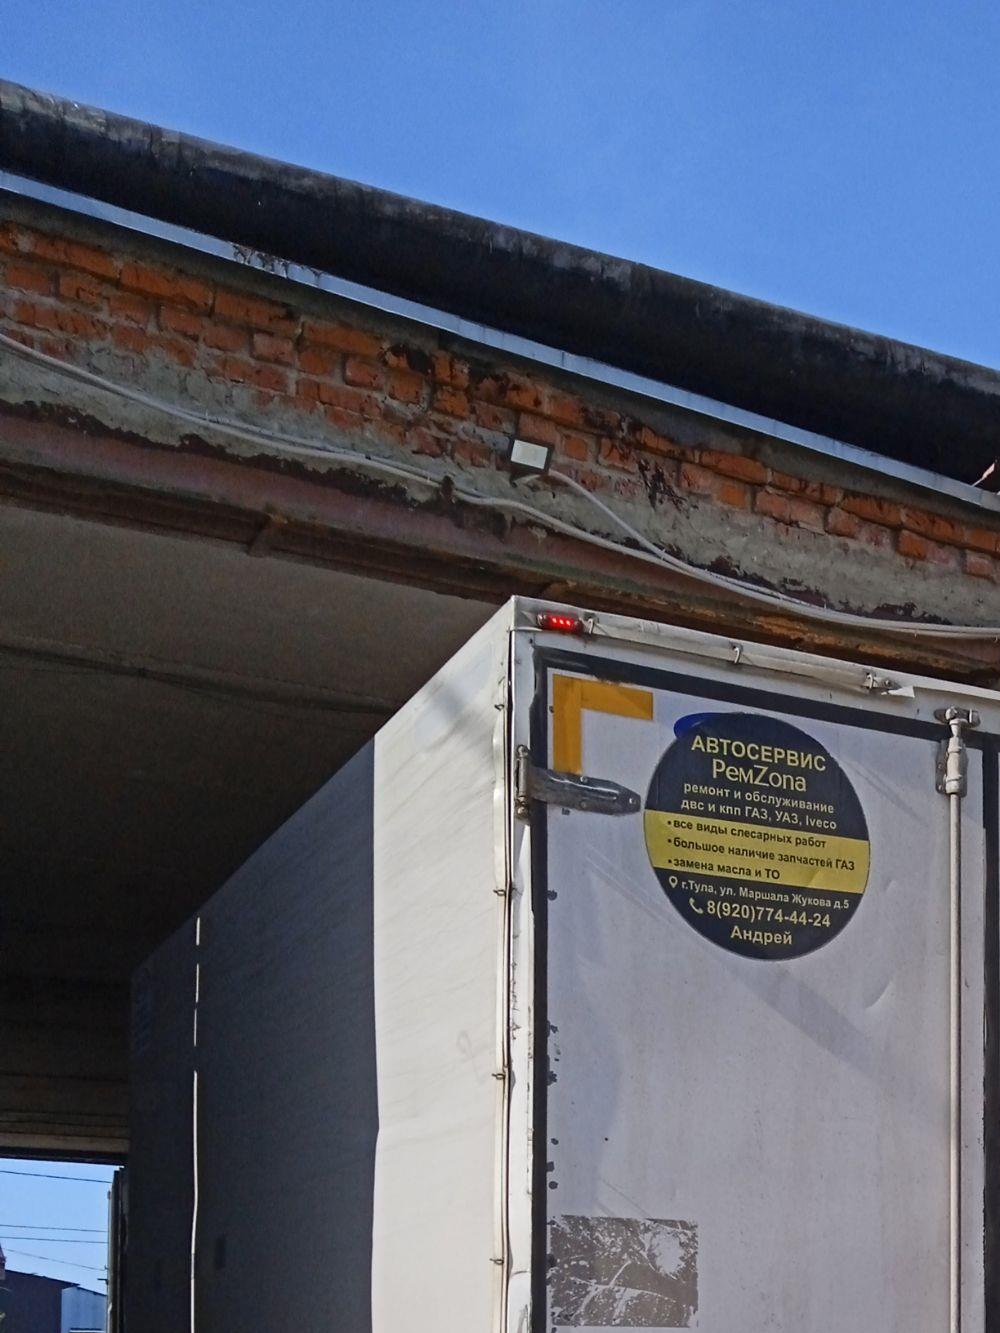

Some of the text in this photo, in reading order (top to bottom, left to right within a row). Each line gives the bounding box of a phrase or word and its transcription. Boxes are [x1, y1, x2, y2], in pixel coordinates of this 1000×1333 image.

[691, 735, 826, 771] АВТОСЕРВИС
[684, 783, 834, 813] ремонт и обслуживание
[681, 800, 704, 810] двс
[708, 803, 715, 812] и
[720, 805, 741, 816] кпп
[745, 806, 771, 821] ГАЗ,
[806, 815, 837, 830] Iveco
[674, 819, 826, 848] все виды слесарных работ
[674, 837, 855, 871] большое наличие запчастей ГАЗ
[674, 858, 780, 880] замена масла и ТО
[720, 885, 736, 897] ул.
[739, 887, 789, 903] Маршала
[792, 893, 831, 908] Жукова
[707, 900, 831, 928] 8(920)774-44-24
[730, 925, 793, 946] Андрей
